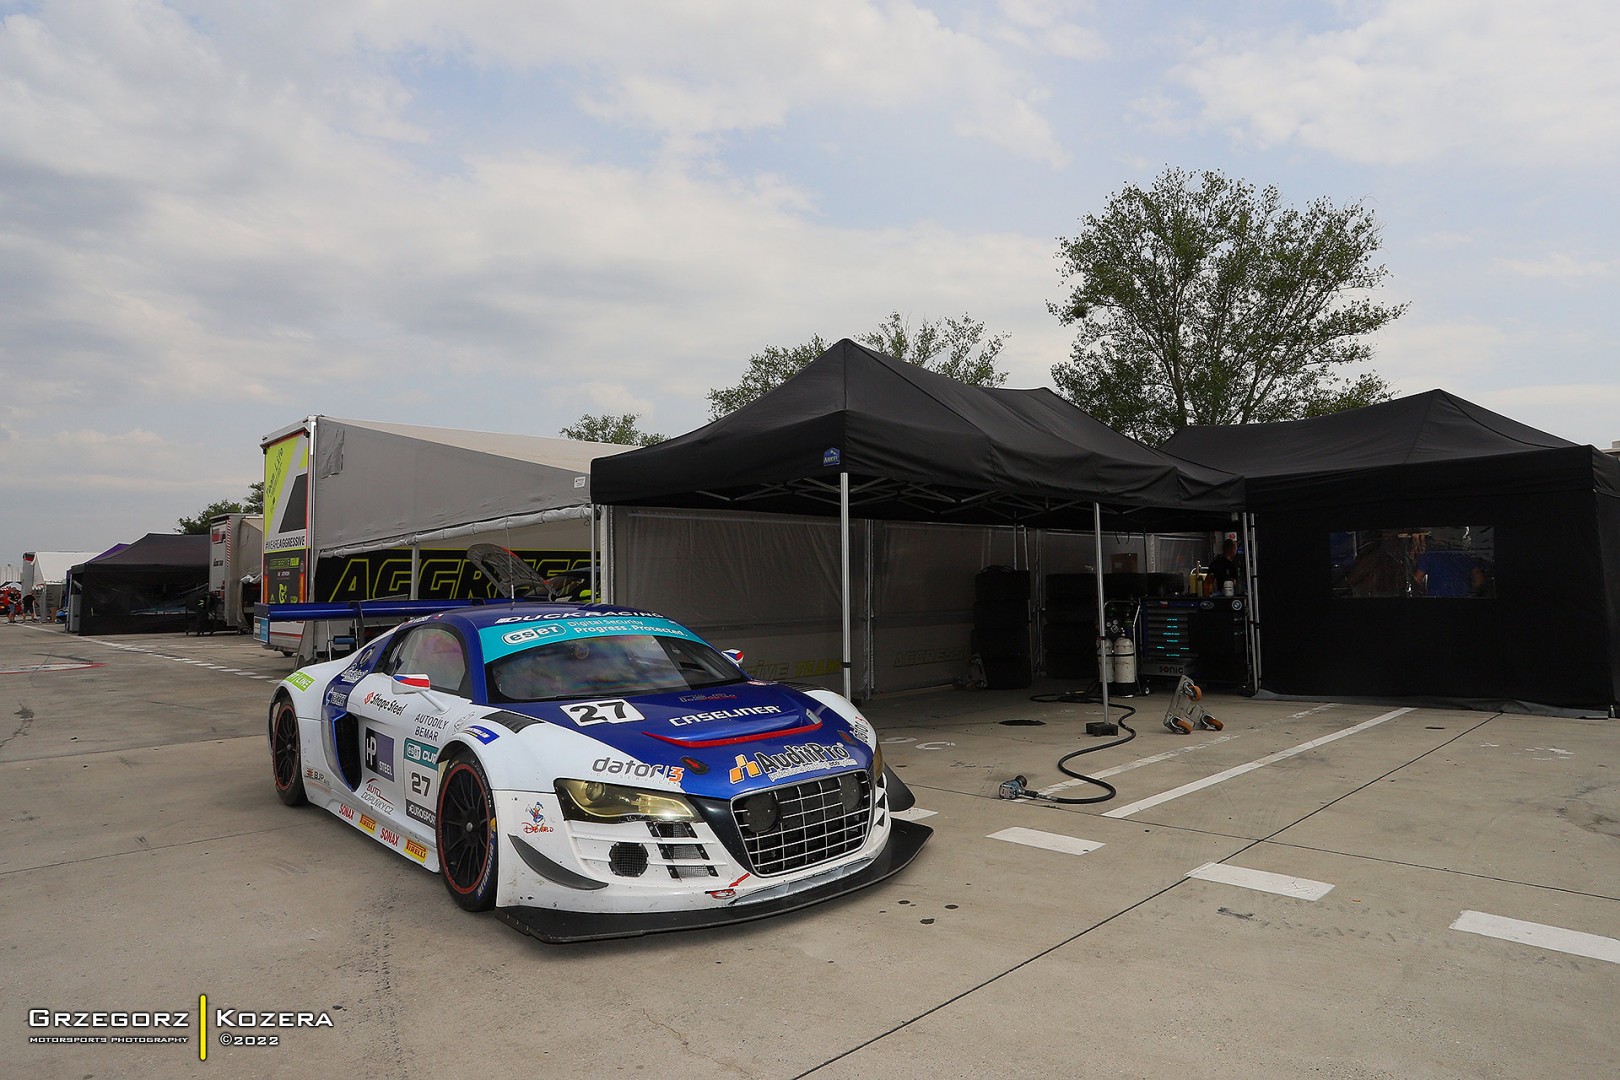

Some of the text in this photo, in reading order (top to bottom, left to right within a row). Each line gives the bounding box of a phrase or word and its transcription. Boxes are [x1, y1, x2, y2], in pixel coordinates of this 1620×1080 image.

[495, 612, 579, 624] DUCK
[567, 619, 603, 627] Digital
[575, 625, 688, 637] Progress. Protected.
[569, 701, 627, 722] 27
[668, 705, 782, 727] CASELINER
[414, 713, 449, 730] AUTODÍLY
[415, 726, 439, 742] BEMAR
[379, 761, 393, 776] STEEL
[411, 772, 431, 797] 27
[339, 803, 355, 820] SONAX
[361, 815, 375, 830] PIRELLI
[380, 828, 400, 846] SONAX
[406, 840, 427, 859] PIRELLI
